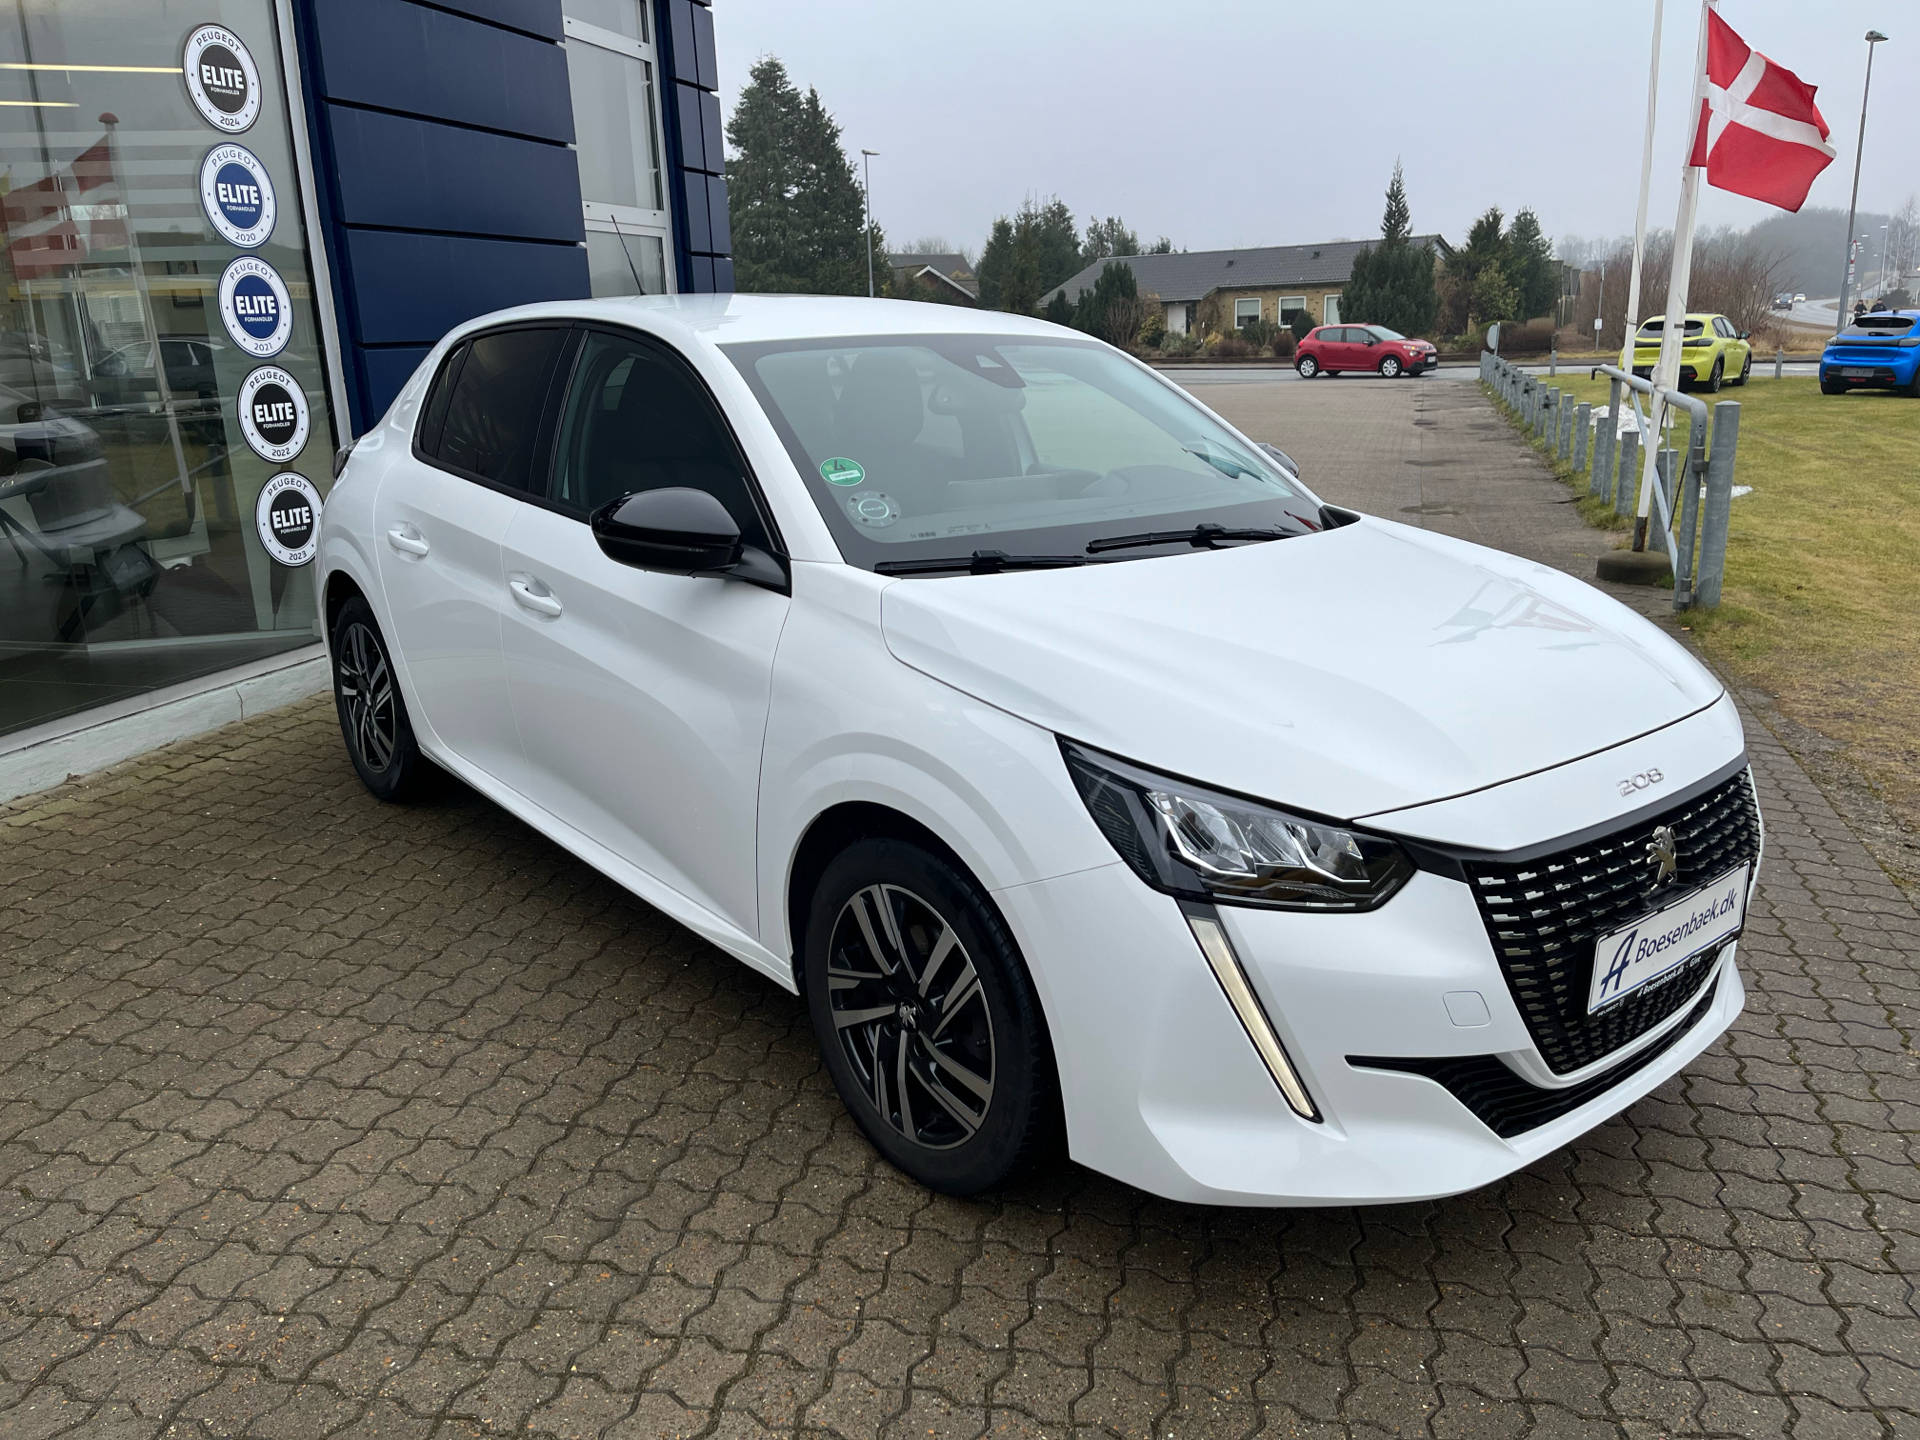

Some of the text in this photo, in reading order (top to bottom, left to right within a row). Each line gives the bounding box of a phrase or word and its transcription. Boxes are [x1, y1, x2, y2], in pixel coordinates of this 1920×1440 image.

[196, 31, 241, 53] PEUGEOT
[201, 64, 245, 90] ELITE
[210, 86, 240, 96] FORHANDLER
[220, 115, 241, 127] 2024
[211, 149, 257, 171] PEUGEOT
[217, 182, 260, 205] ELITE
[226, 204, 256, 213] FORHANDLER
[235, 231, 256, 242] 2020
[229, 262, 275, 281] PEUGEOT
[235, 295, 277, 315] ELITE
[254, 342, 273, 352] 2021
[250, 371, 291, 389] PEUGEOT
[254, 402, 295, 423] ELITE
[263, 421, 291, 429] FORHANDLER
[271, 447, 291, 457] 2022
[267, 477, 308, 497] PEUGEOT
[271, 506, 311, 529] ELITE
[280, 525, 307, 535] FORHANDLER
[289, 550, 307, 560] 2023
[1616, 767, 1665, 797] 208
[1634, 887, 1738, 964] Boesenbaek.dk
